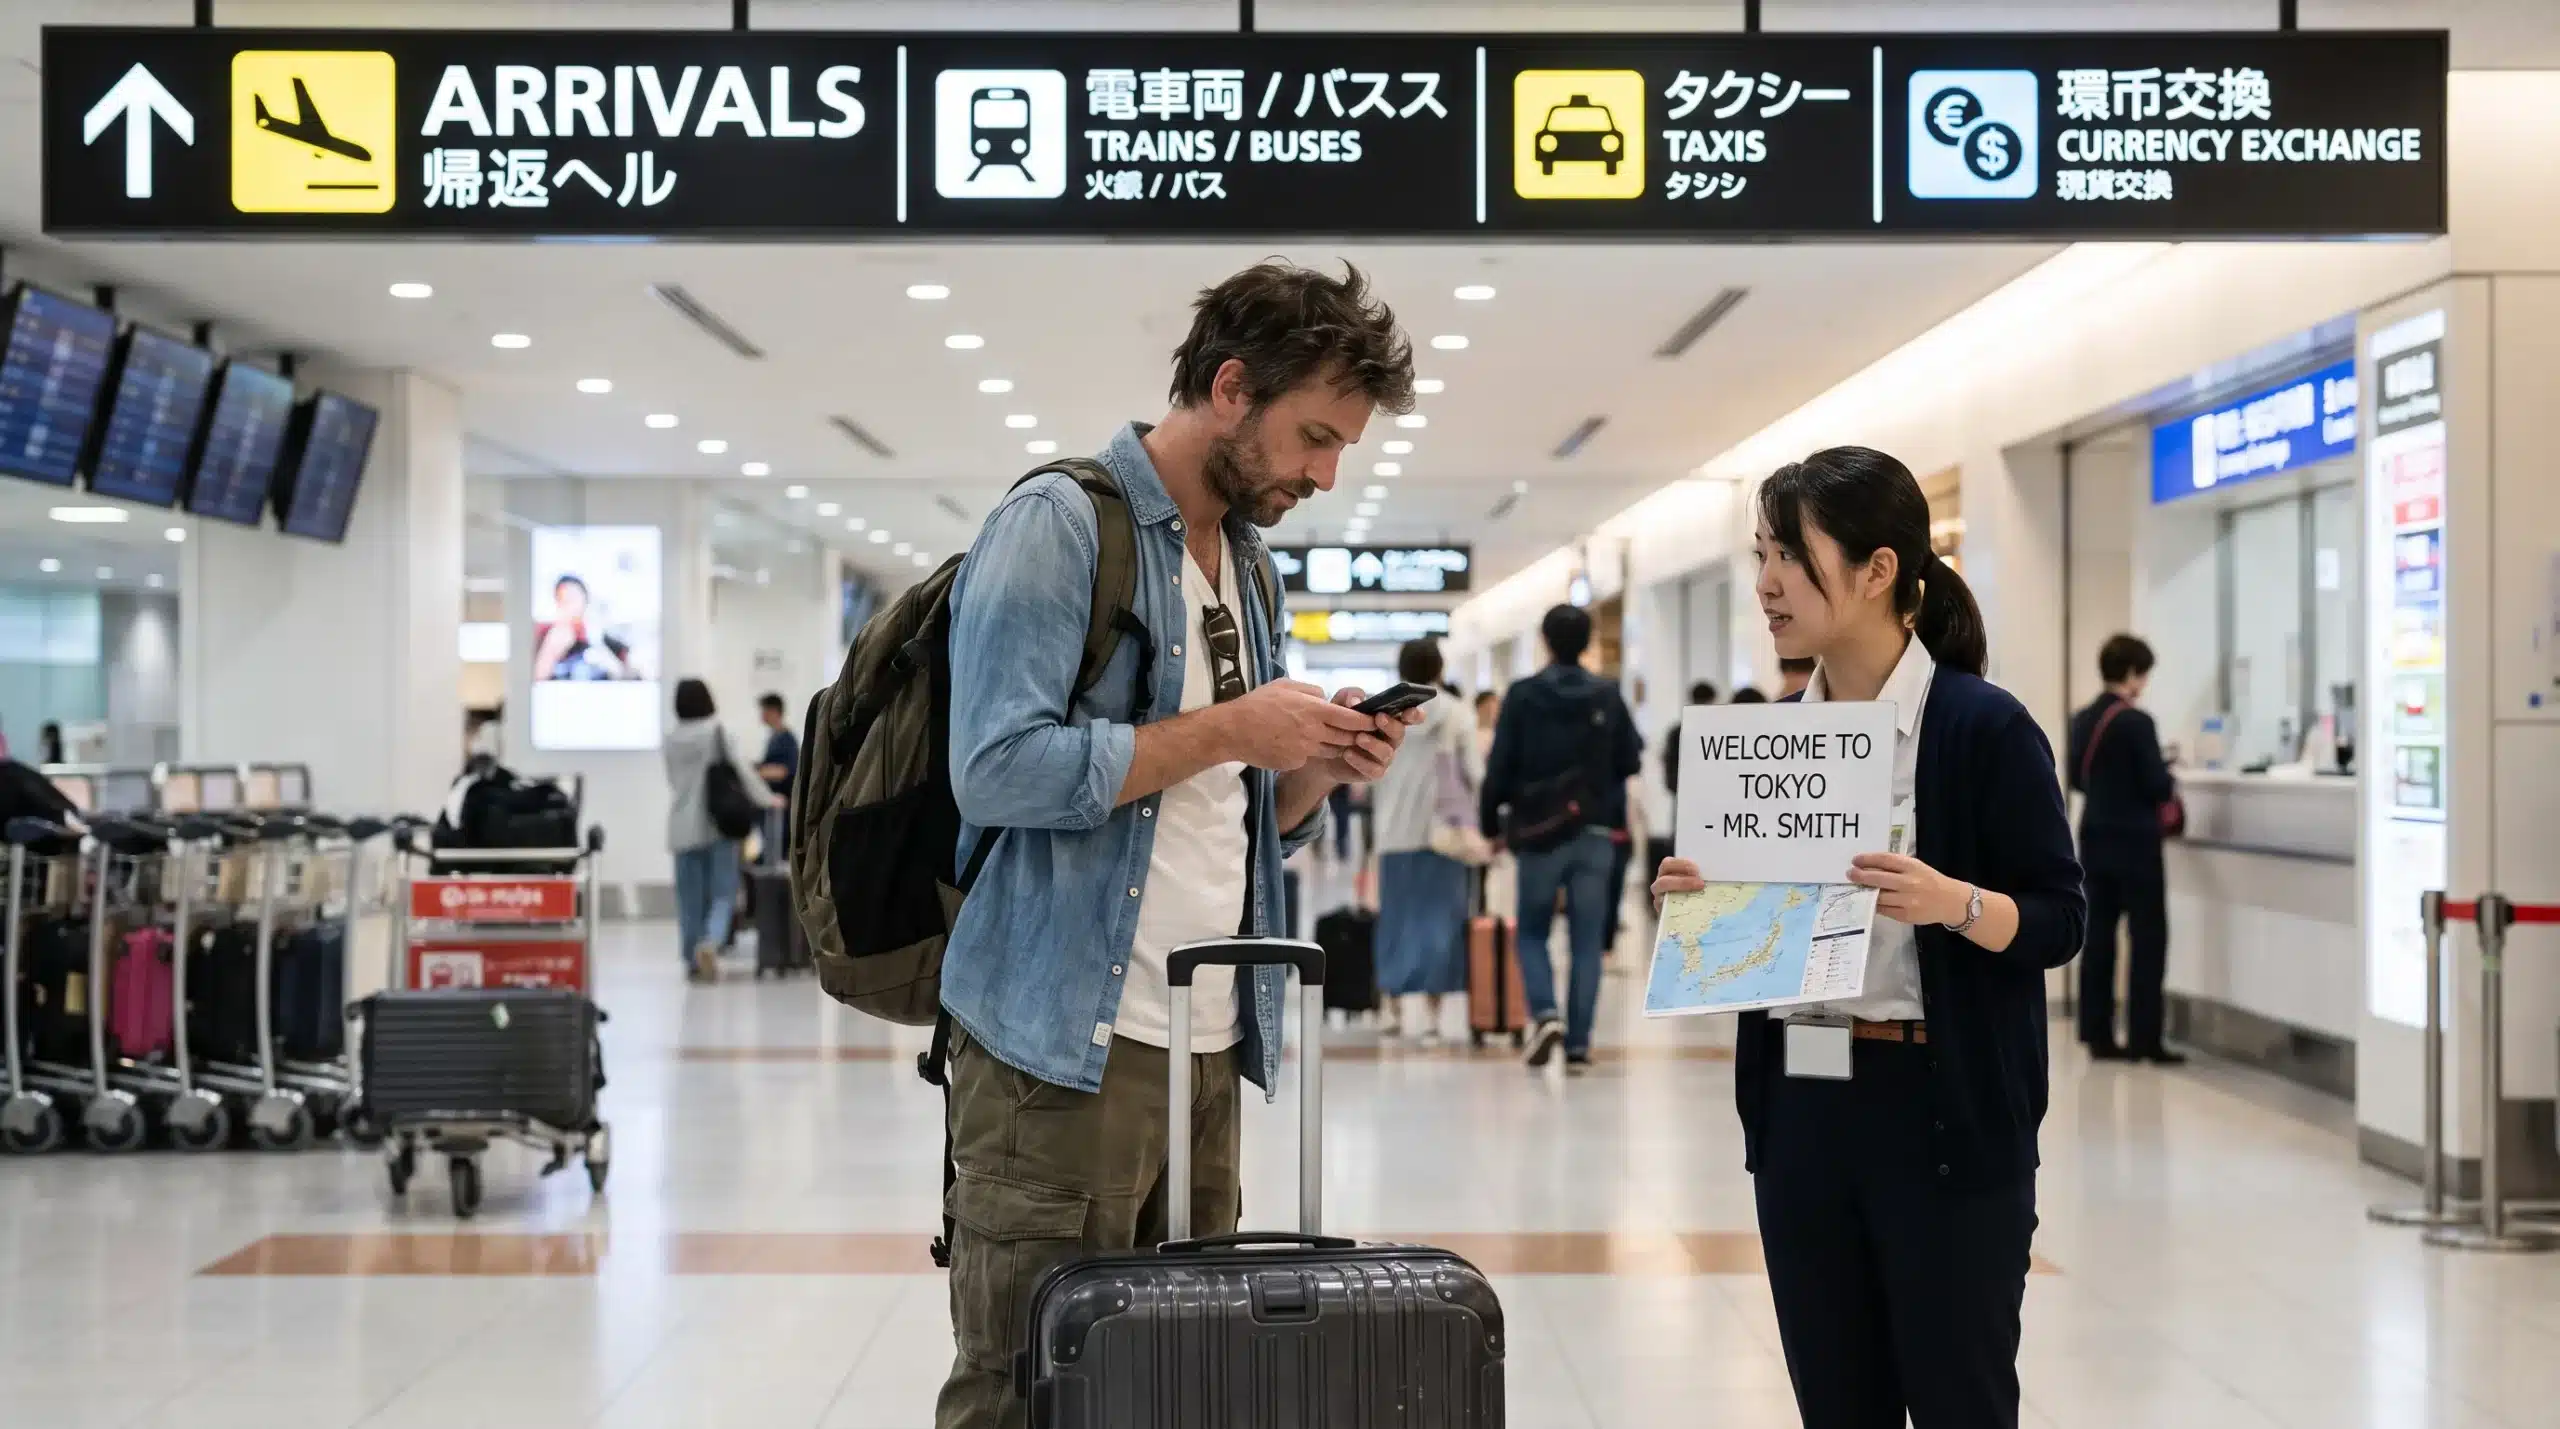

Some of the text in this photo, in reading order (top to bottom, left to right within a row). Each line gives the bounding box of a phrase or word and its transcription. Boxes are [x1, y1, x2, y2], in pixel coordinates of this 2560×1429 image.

[420, 64, 866, 139] ARRIVALS
[1085, 66, 1448, 122] 電車両 / バスス
[1663, 69, 1851, 120] タクシー
[1083, 129, 1363, 163] TRAINS / BUSES
[1662, 129, 1767, 163] TAXIS
[2057, 127, 2421, 163] CURRENCY EXCHANGE
[1148, 172, 1164, 199] /
[1169, 169, 1227, 200] バス
[1664, 170, 1747, 201] タシシ
[1700, 732, 1872, 761] WELCOME TO
[1738, 772, 1826, 800] TOKYO
[1723, 813, 1767, 838] MR.
[1777, 812, 1859, 839] SMITH
